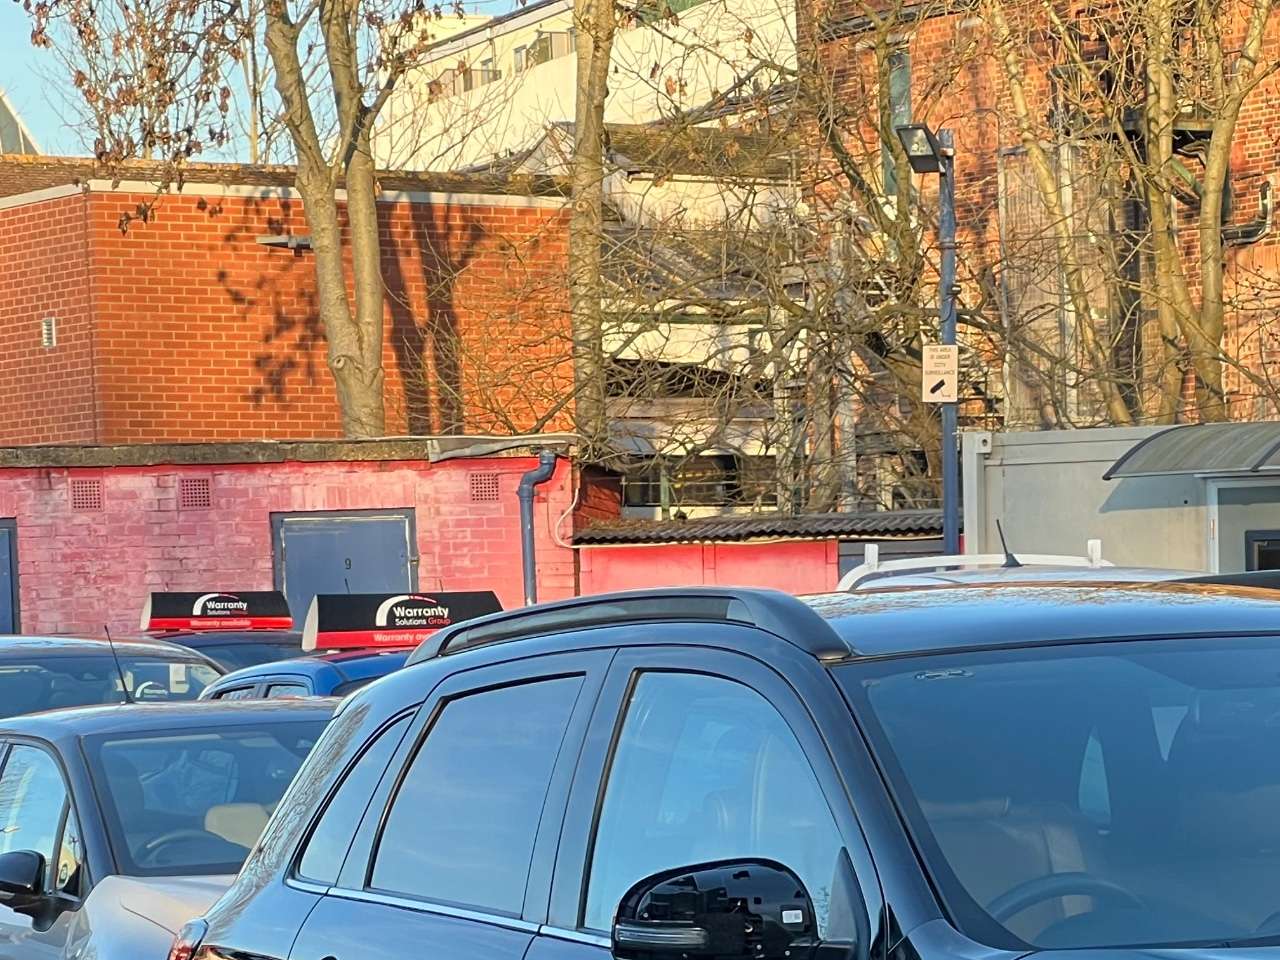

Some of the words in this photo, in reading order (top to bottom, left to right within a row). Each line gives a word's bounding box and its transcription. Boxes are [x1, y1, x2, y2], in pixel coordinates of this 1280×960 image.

[344, 558, 352, 570] 9
[206, 601, 248, 611] Warranty
[393, 606, 449, 618] Warranty
[395, 618, 427, 626] Solutions
[427, 616, 451, 626] Group
[373, 632, 414, 642] Warranty
